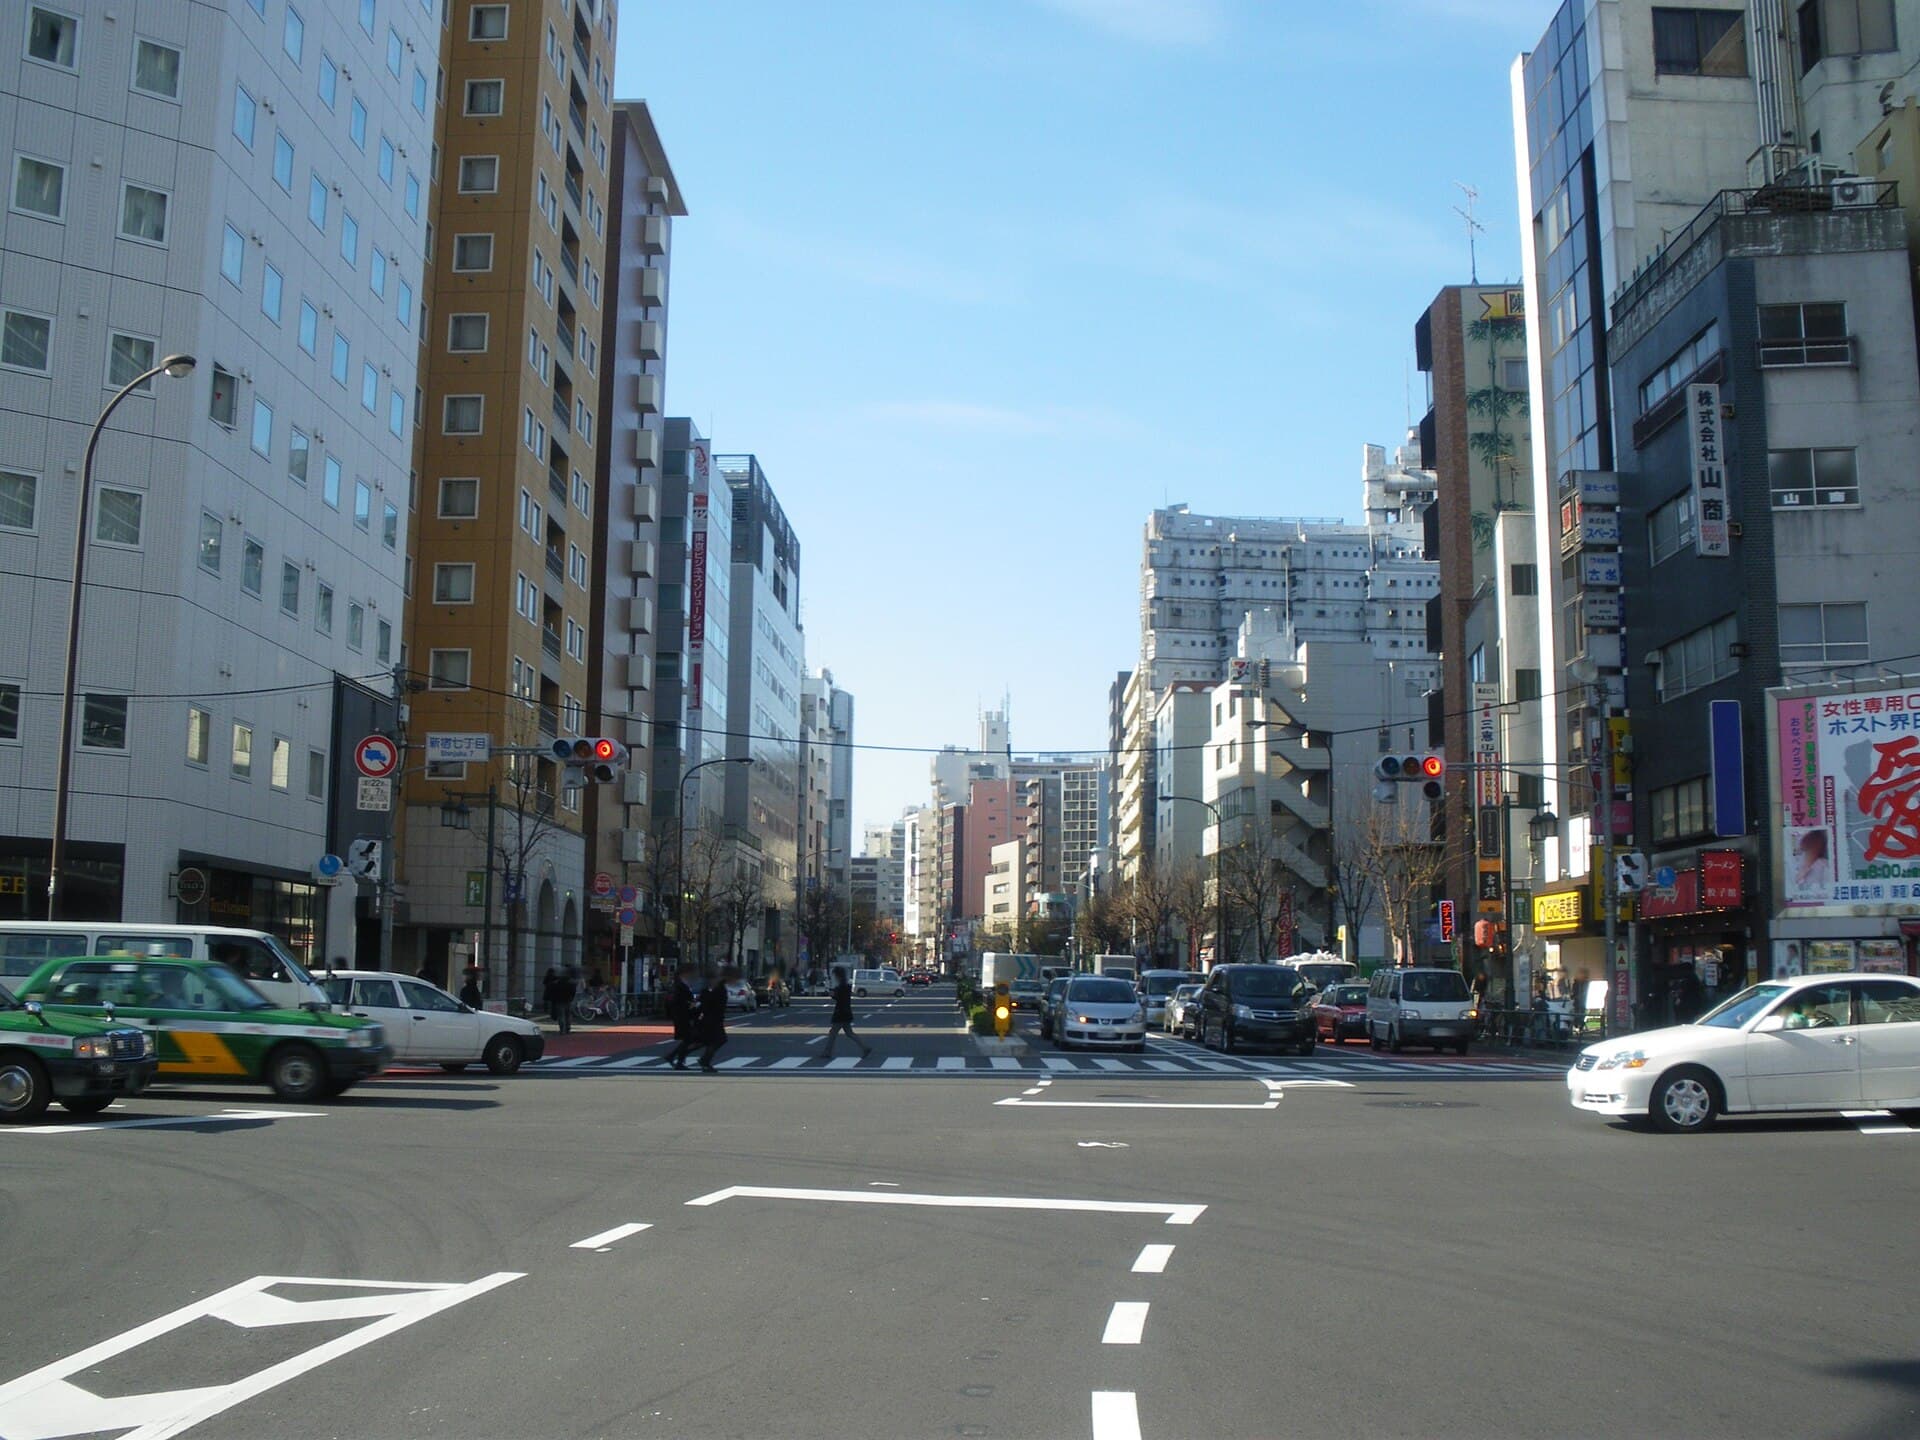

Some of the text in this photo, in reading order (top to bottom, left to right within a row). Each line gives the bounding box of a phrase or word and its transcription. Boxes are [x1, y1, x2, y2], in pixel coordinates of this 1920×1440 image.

[429, 736, 486, 750] 新宿七丁目
[1705, 860, 1737, 870] ラーメン
